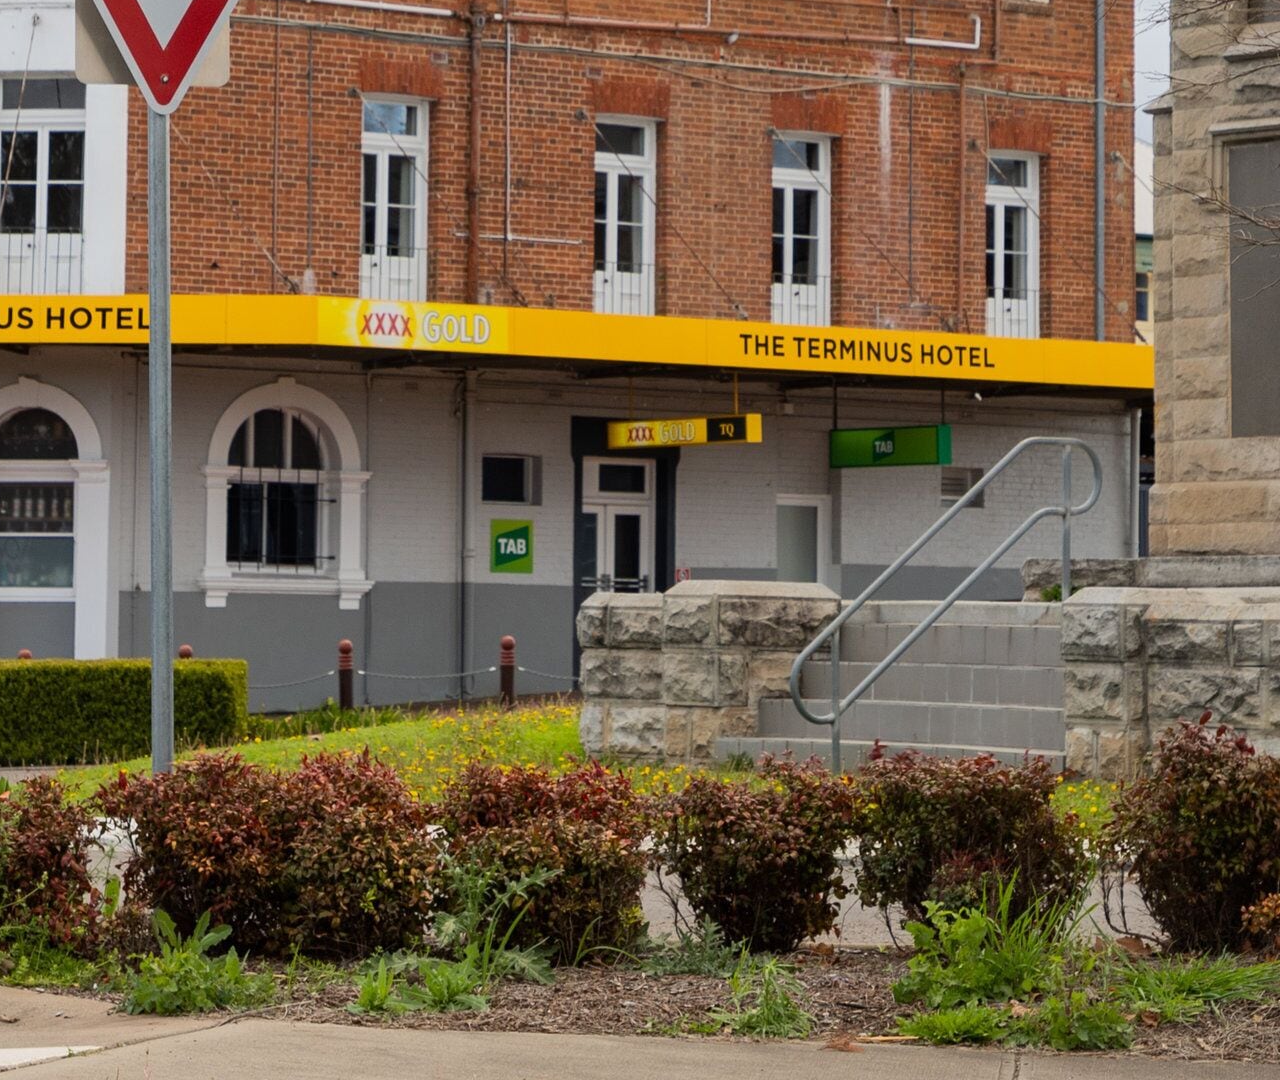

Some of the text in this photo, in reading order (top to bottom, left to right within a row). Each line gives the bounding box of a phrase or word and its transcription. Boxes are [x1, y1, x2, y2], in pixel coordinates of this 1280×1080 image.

[46, 306, 150, 330] HOTEL
[360, 311, 491, 344] XXXX GOLD
[739, 334, 995, 368] THE TERMINUS HOTEL
[627, 422, 695, 443] XXXX GOLD
[719, 424, 735, 437] TQ
[874, 440, 893, 453] TAB
[498, 538, 527, 555] TAB
